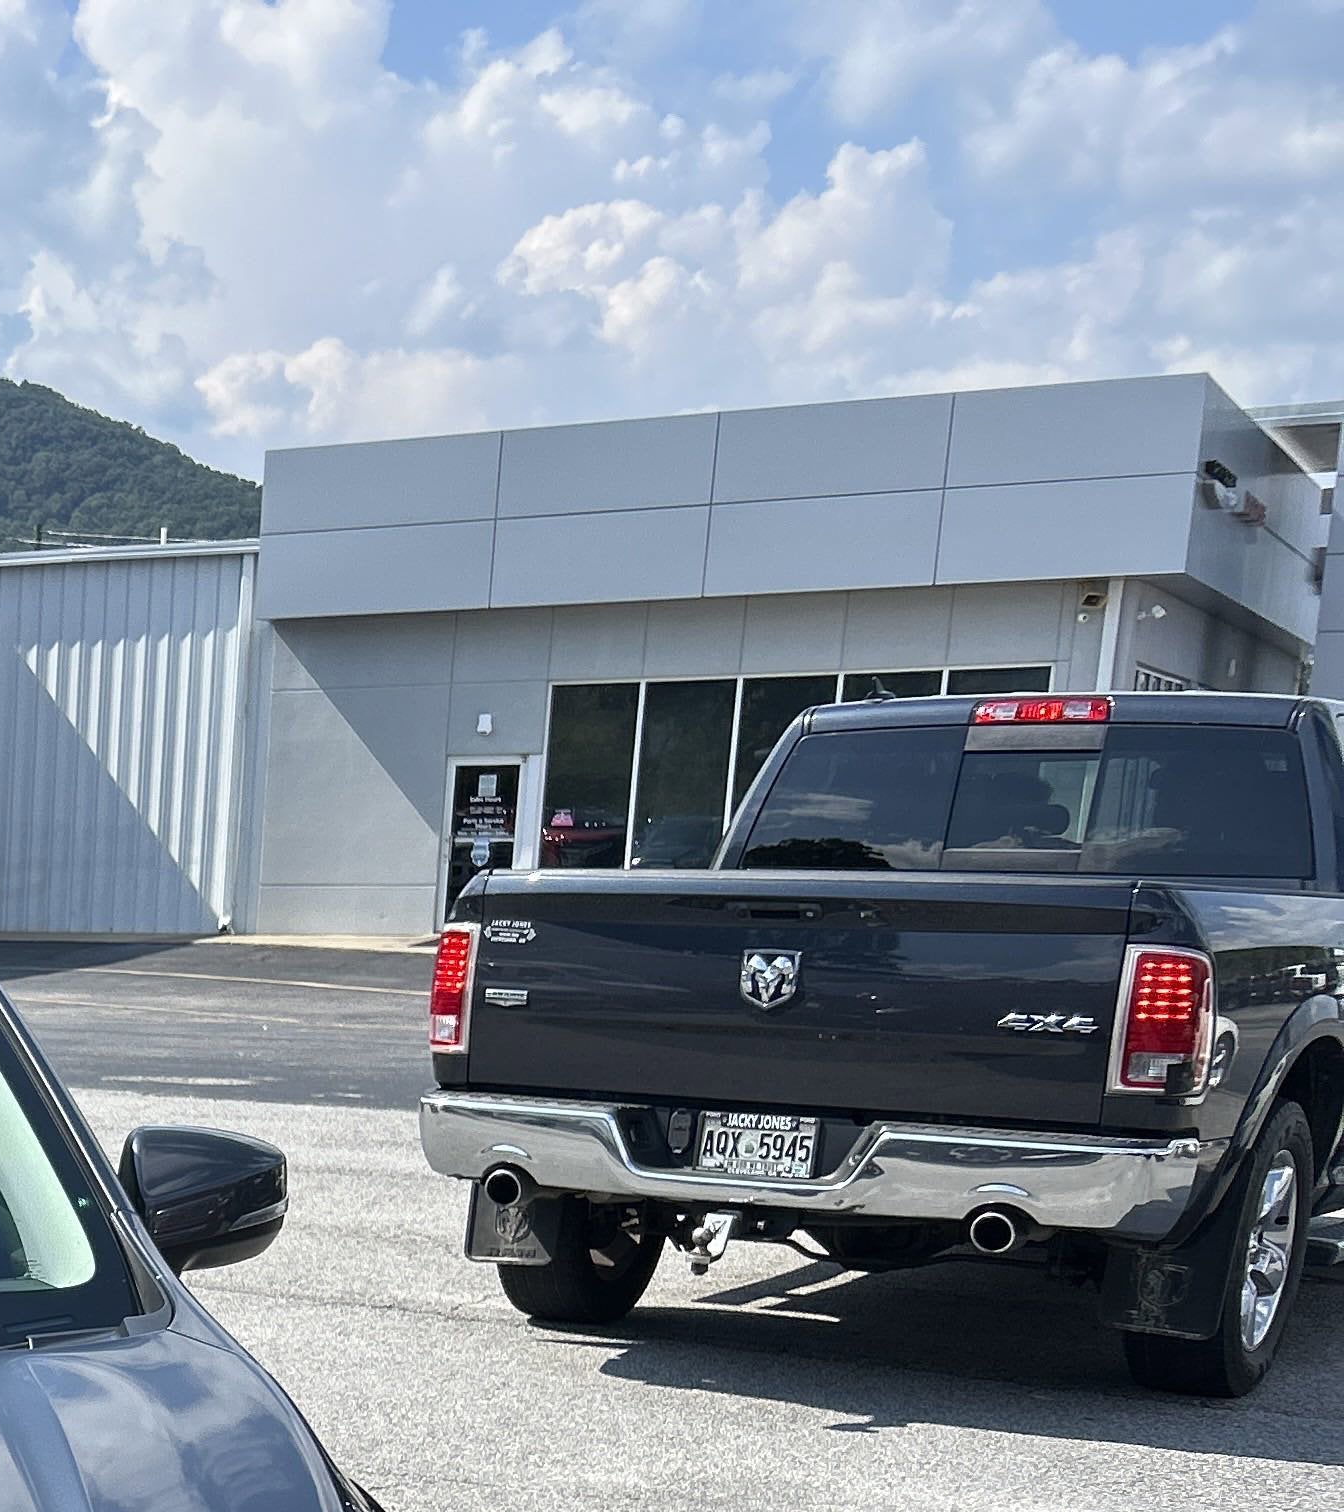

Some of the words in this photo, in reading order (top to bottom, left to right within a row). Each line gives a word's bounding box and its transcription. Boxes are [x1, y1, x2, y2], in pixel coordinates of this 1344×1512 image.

[726, 1112, 758, 1128] JACKY
[758, 1113, 792, 1130] JONES
[703, 1130, 742, 1158] AQX
[758, 1133, 813, 1162] 5945
